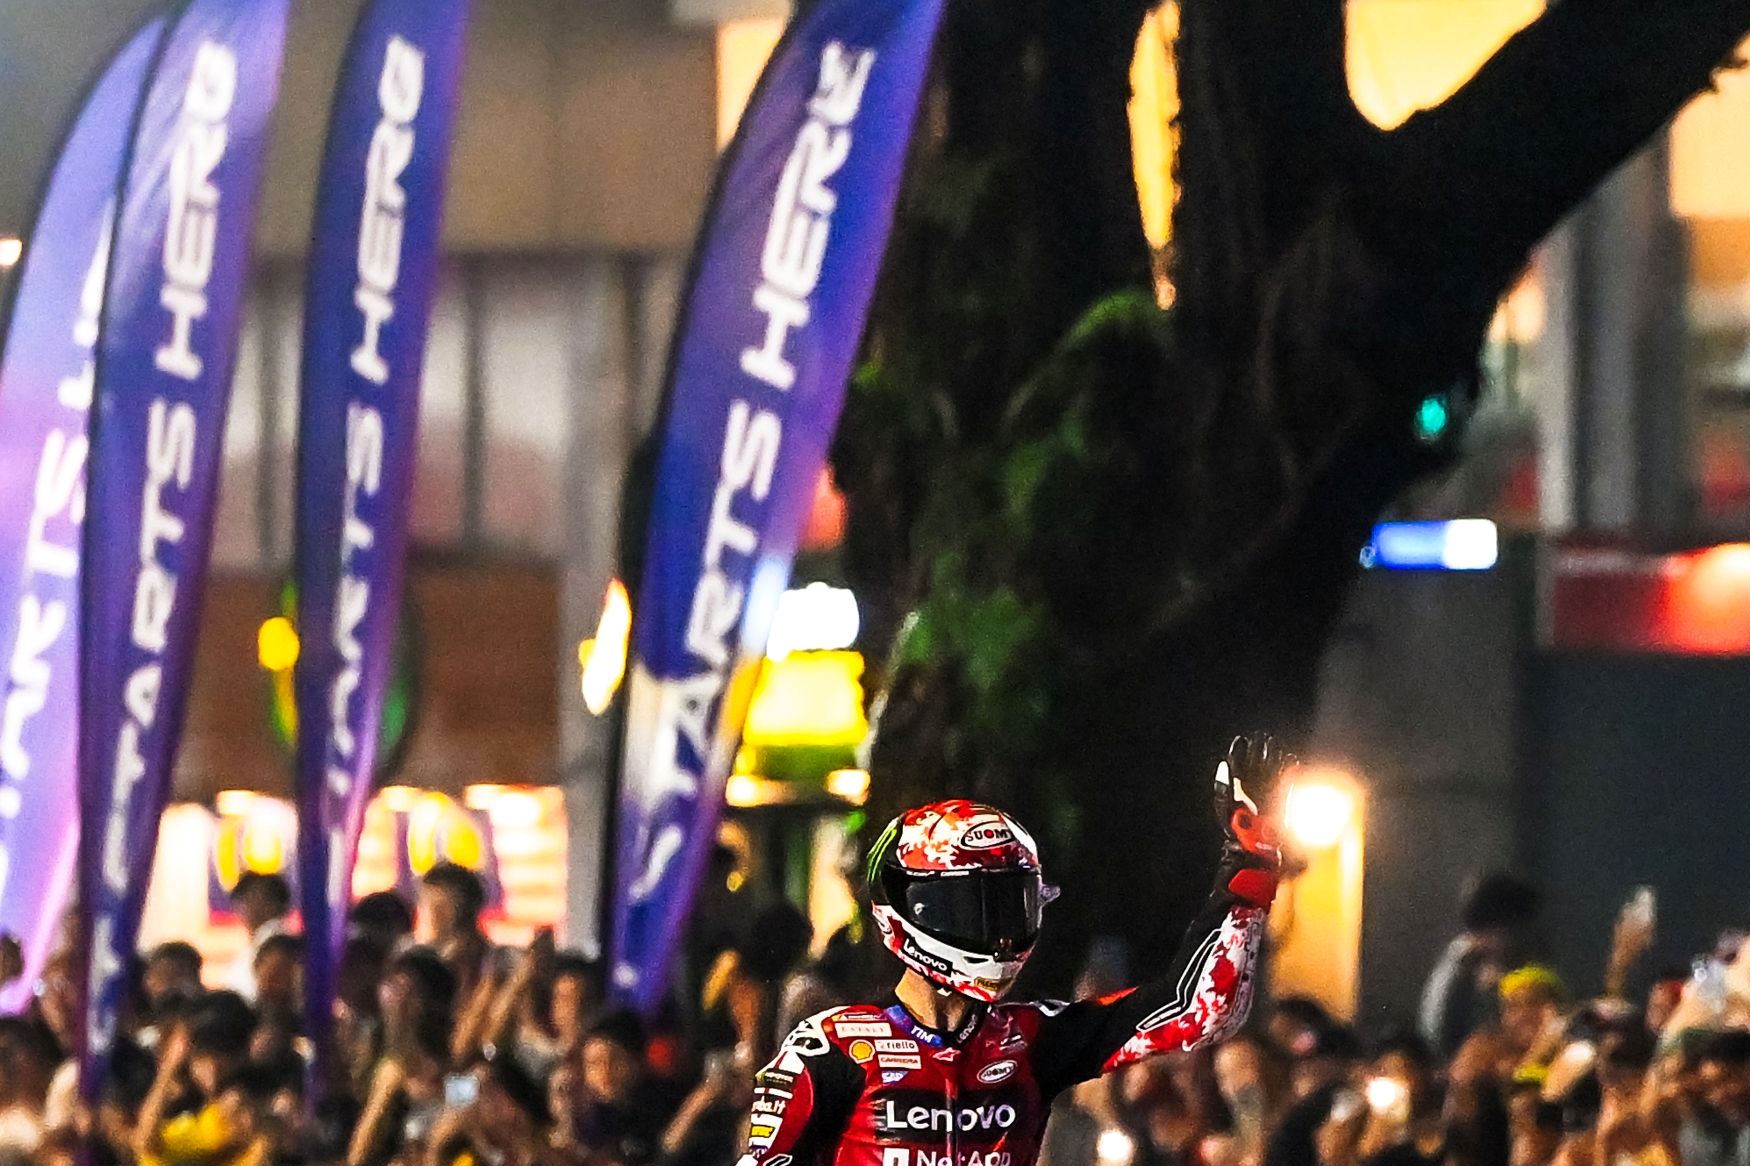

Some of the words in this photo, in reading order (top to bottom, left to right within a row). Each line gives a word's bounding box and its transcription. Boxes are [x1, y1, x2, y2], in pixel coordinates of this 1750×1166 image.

[965, 828, 1012, 843] SUOM
[904, 938, 948, 972] Lenovo
[911, 1025, 934, 1044] TIM
[887, 1040, 916, 1050] riello
[886, 1100, 1017, 1132] Lenovo
